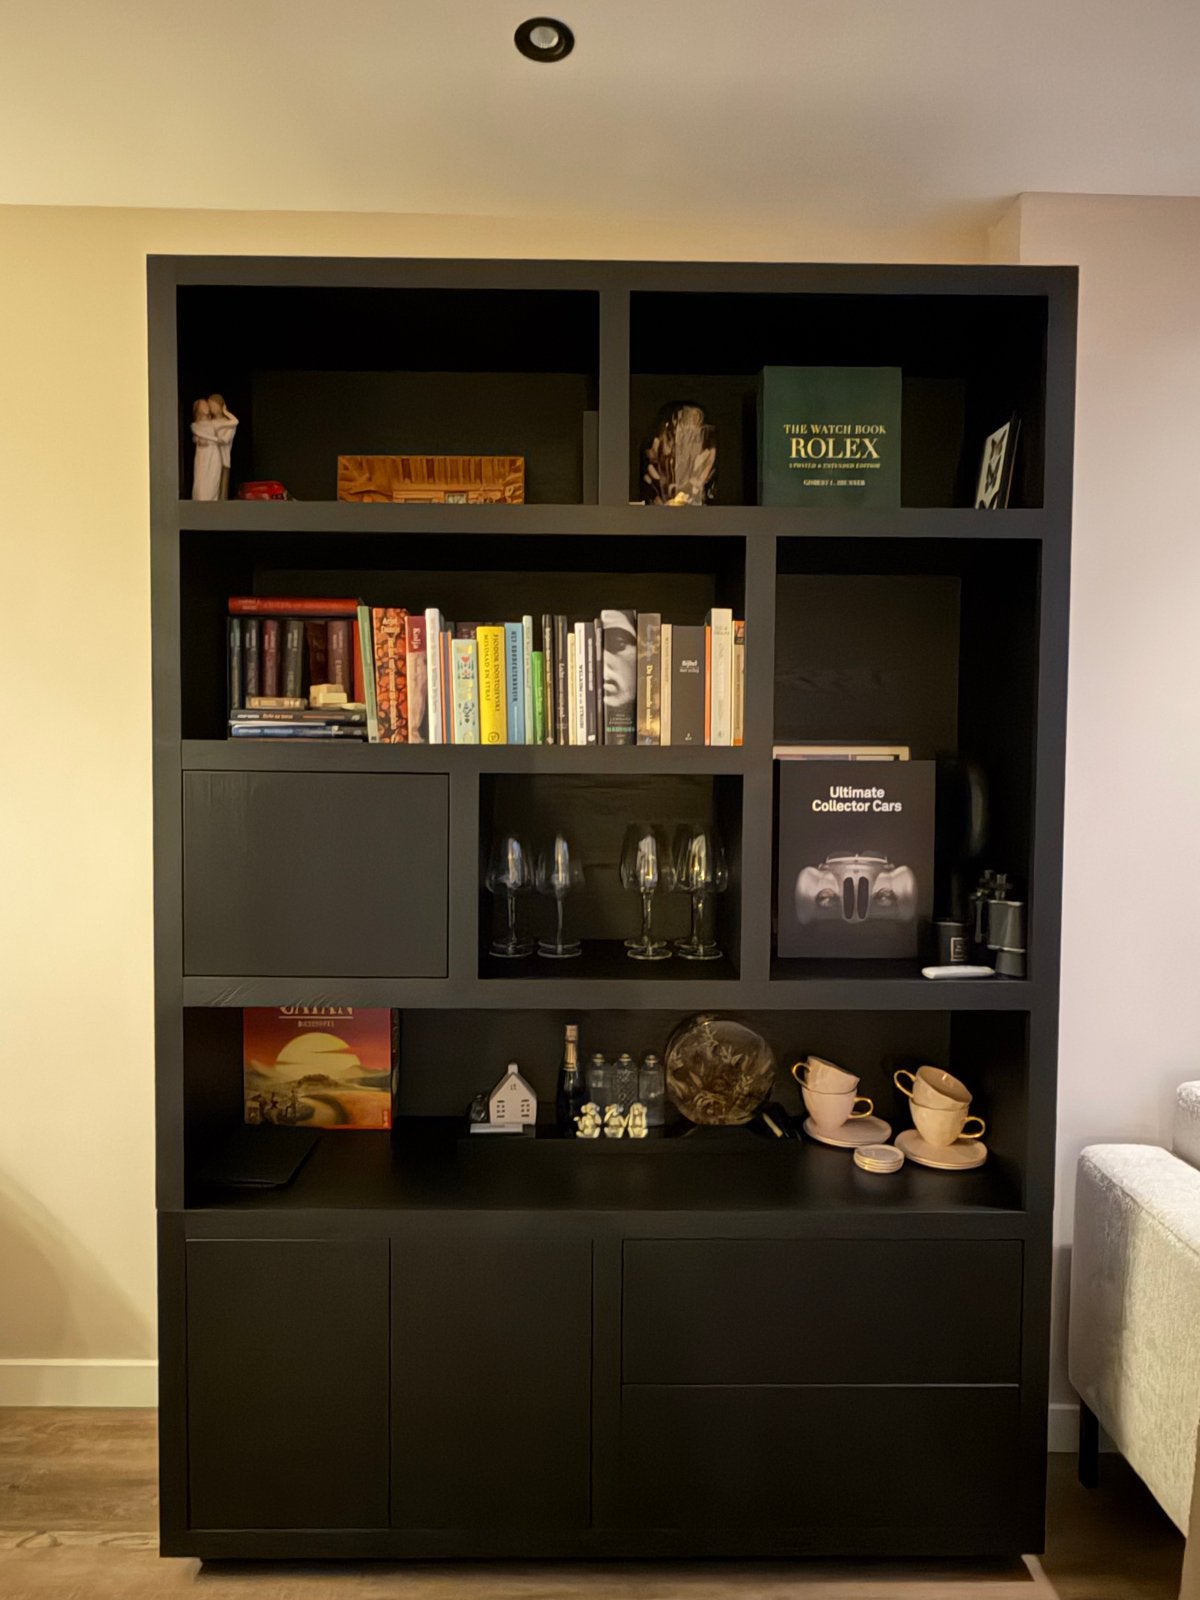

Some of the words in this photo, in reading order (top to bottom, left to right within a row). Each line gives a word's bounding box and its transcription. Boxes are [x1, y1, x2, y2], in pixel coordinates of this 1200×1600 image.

[783, 424, 807, 434] THE
[810, 424, 851, 435] WATCH
[855, 424, 887, 435] BOOK
[789, 437, 880, 459] ROLEX
[829, 786, 885, 798] Ultimate
[812, 800, 871, 812] Collector
[872, 800, 903, 812] Cars
